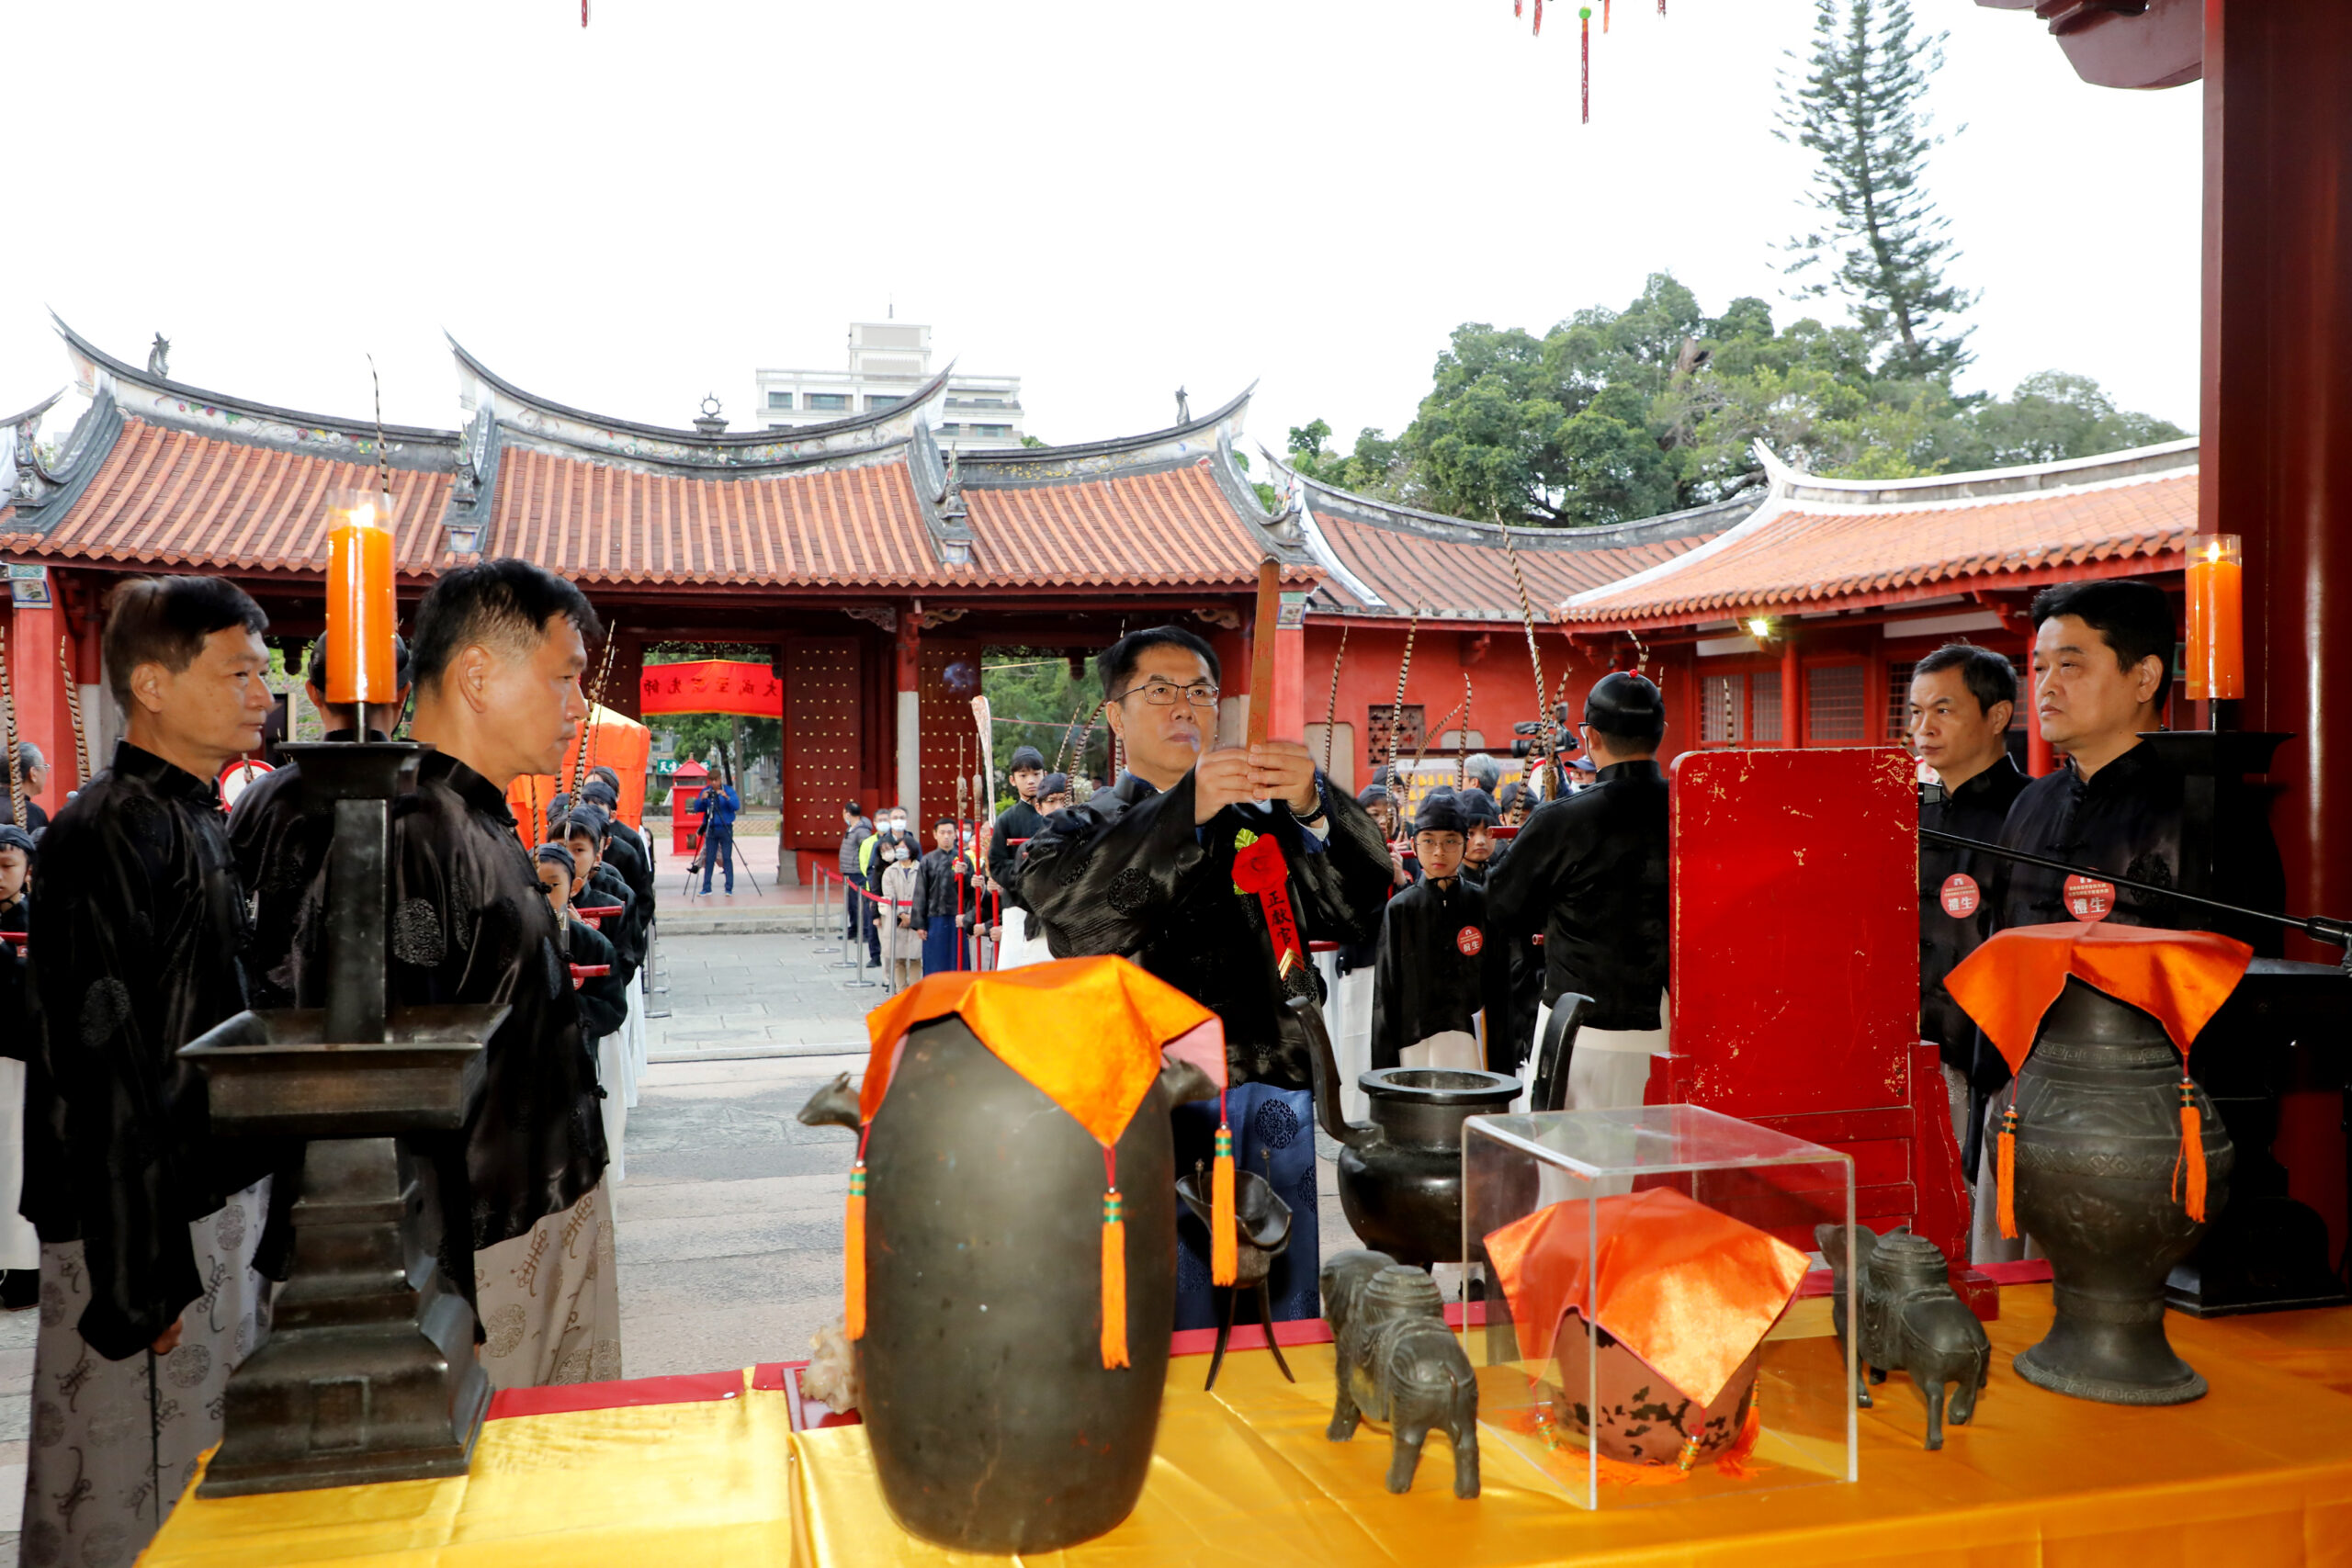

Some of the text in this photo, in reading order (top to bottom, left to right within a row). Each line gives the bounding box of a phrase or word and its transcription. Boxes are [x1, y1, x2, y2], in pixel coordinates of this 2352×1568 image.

[1948, 897, 1973, 912] 禮生
[2072, 897, 2107, 915] 禮生
[1267, 890, 1293, 946] 正獻官
